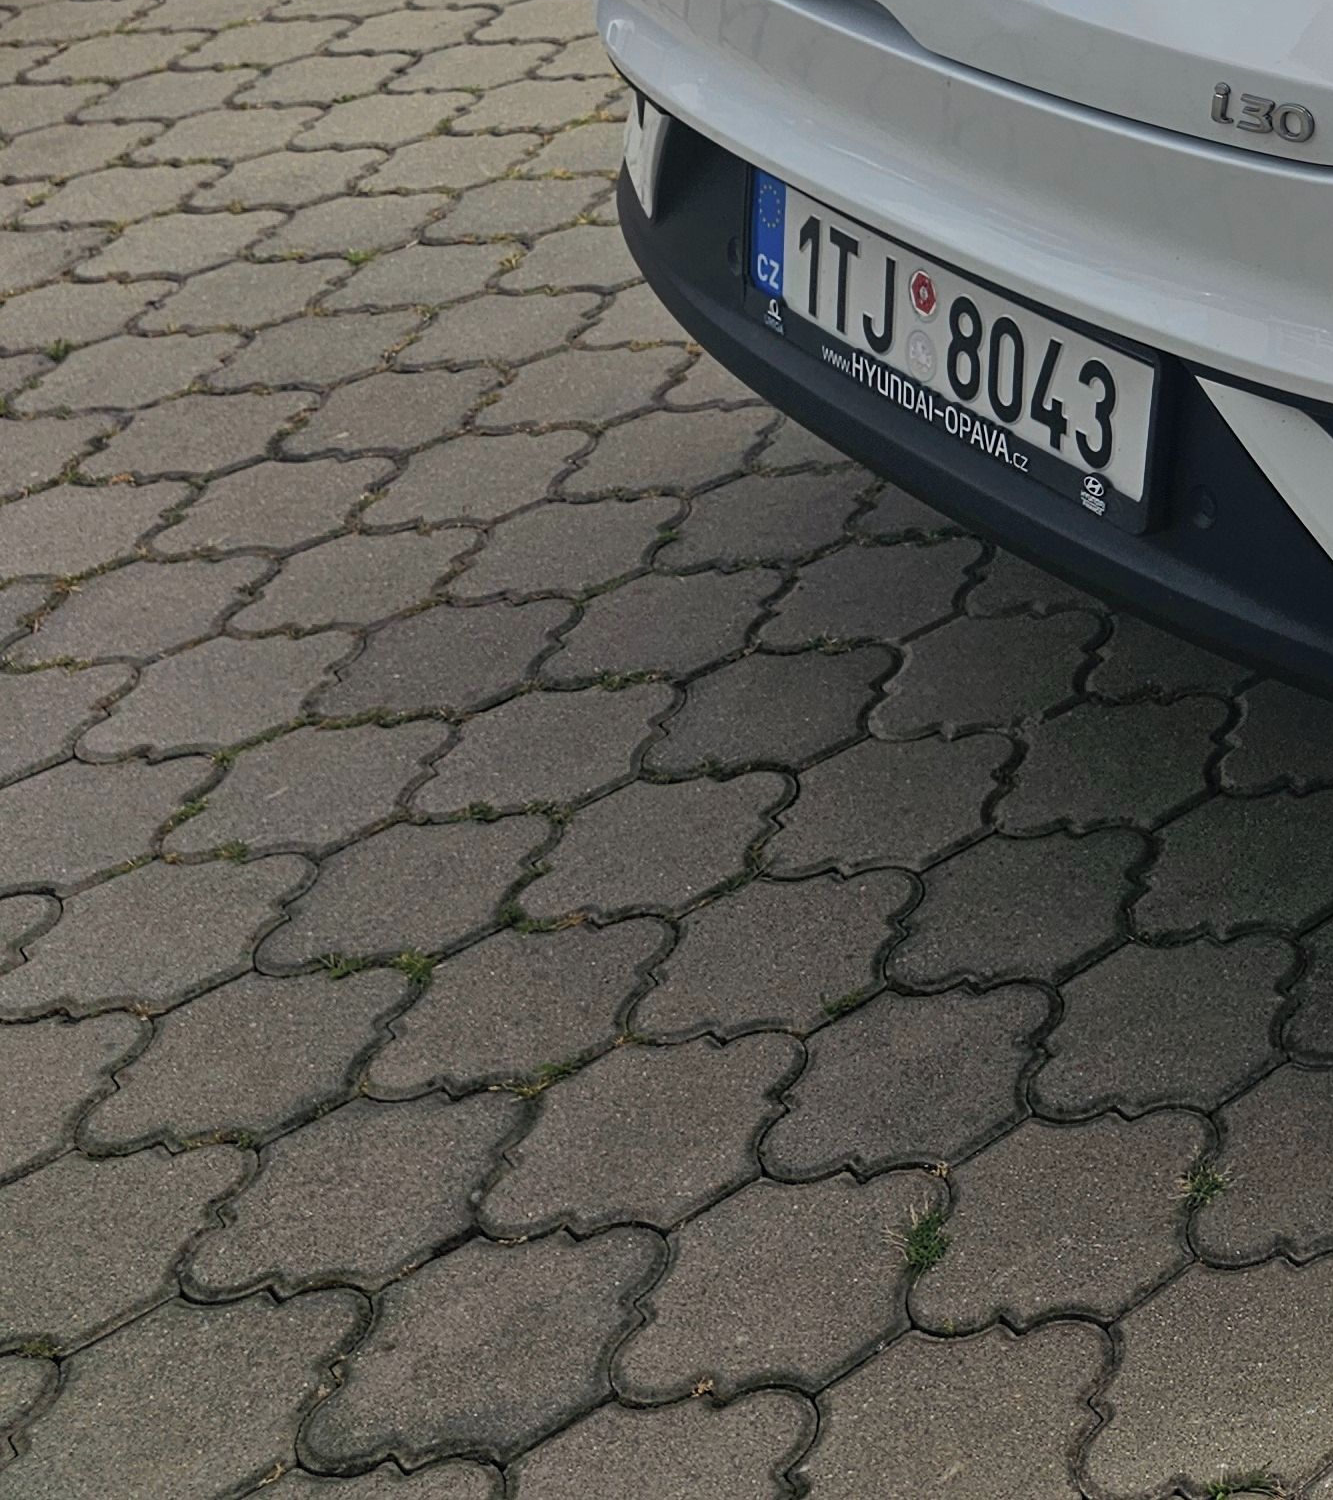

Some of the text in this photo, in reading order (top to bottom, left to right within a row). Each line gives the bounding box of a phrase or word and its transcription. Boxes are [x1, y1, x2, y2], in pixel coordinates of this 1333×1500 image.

[1210, 81, 1315, 143] i30
[757, 252, 780, 291] CZ
[799, 214, 1117, 470] 1TJ 8043
